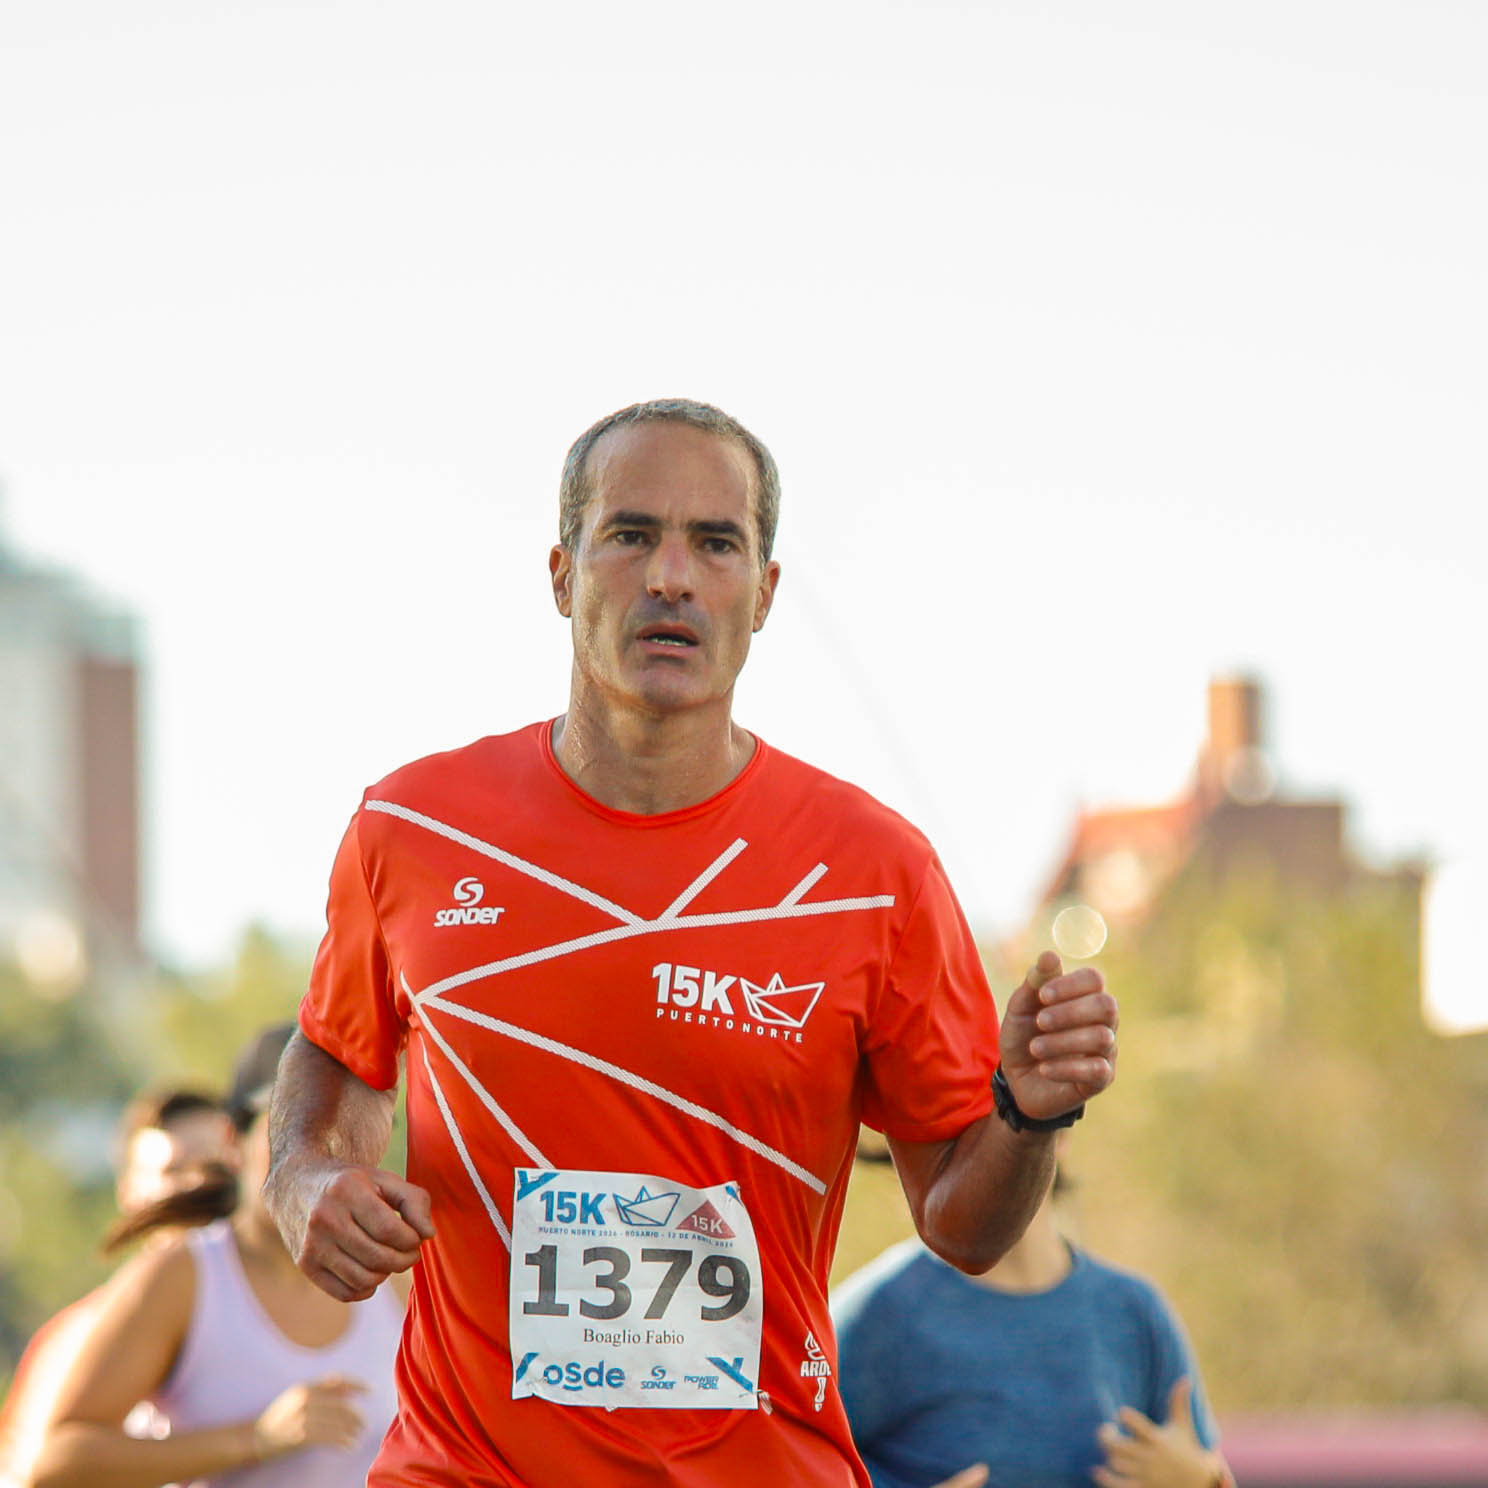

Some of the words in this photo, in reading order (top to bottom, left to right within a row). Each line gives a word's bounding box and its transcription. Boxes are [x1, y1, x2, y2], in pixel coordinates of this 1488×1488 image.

[652, 962, 737, 1015] 15K
[657, 1009, 733, 1029] PUERTO
[743, 1023, 802, 1043] NORTE
[540, 1190, 607, 1225] 15K
[538, 1226, 568, 1234] PUERTO
[571, 1228, 597, 1236] NORTE
[625, 1230, 659, 1238] ROSARIO
[679, 1232, 689, 1240] DE
[692, 1215, 724, 1234] 15K
[522, 1244, 751, 1321] 1379
[583, 1328, 641, 1347] Boaglio
[646, 1329, 685, 1345] Fabio
[543, 1360, 626, 1389] osde
